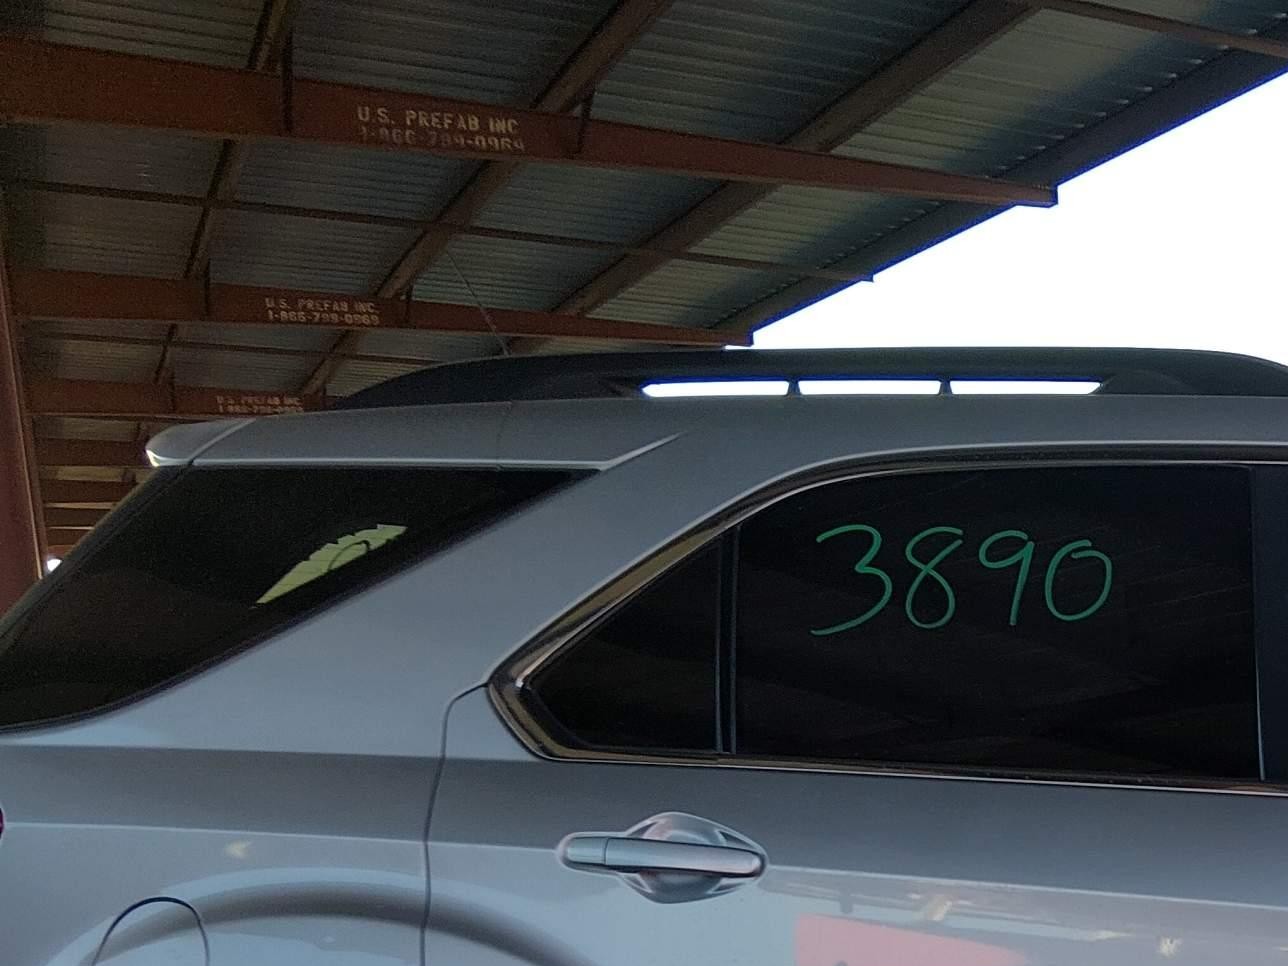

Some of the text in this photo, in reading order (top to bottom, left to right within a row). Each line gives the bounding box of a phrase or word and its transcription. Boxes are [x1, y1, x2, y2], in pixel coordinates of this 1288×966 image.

[405, 110, 480, 131] PREFAB
[297, 299, 349, 312] PREFAB
[810, 523, 1113, 637] 3890
